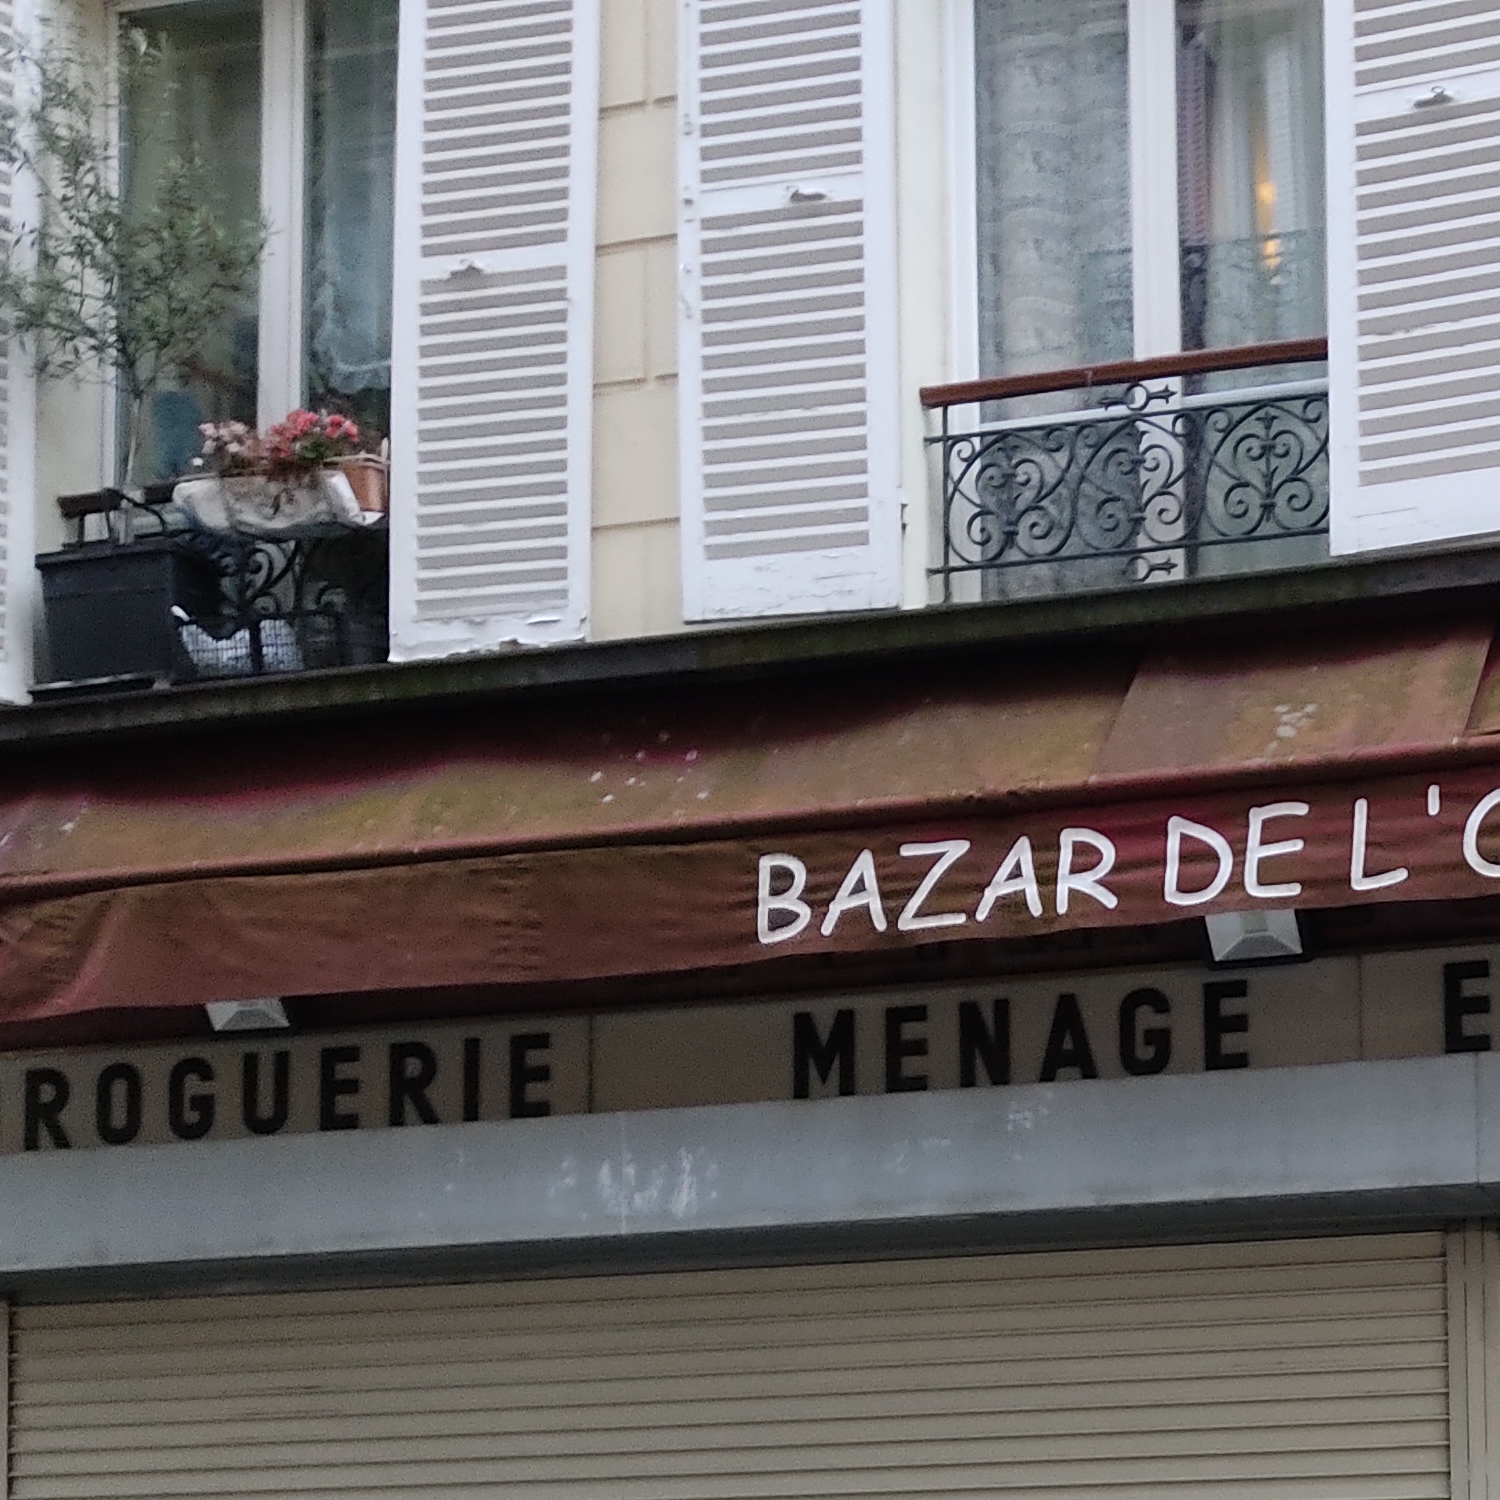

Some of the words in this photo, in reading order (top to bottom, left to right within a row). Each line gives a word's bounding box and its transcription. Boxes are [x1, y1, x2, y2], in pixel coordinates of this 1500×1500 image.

[757, 828, 1118, 944] BAZAR
[1163, 802, 1310, 905] DE
[23, 1032, 552, 1151] ROGUERIE
[792, 979, 1250, 1099] MENAGE
